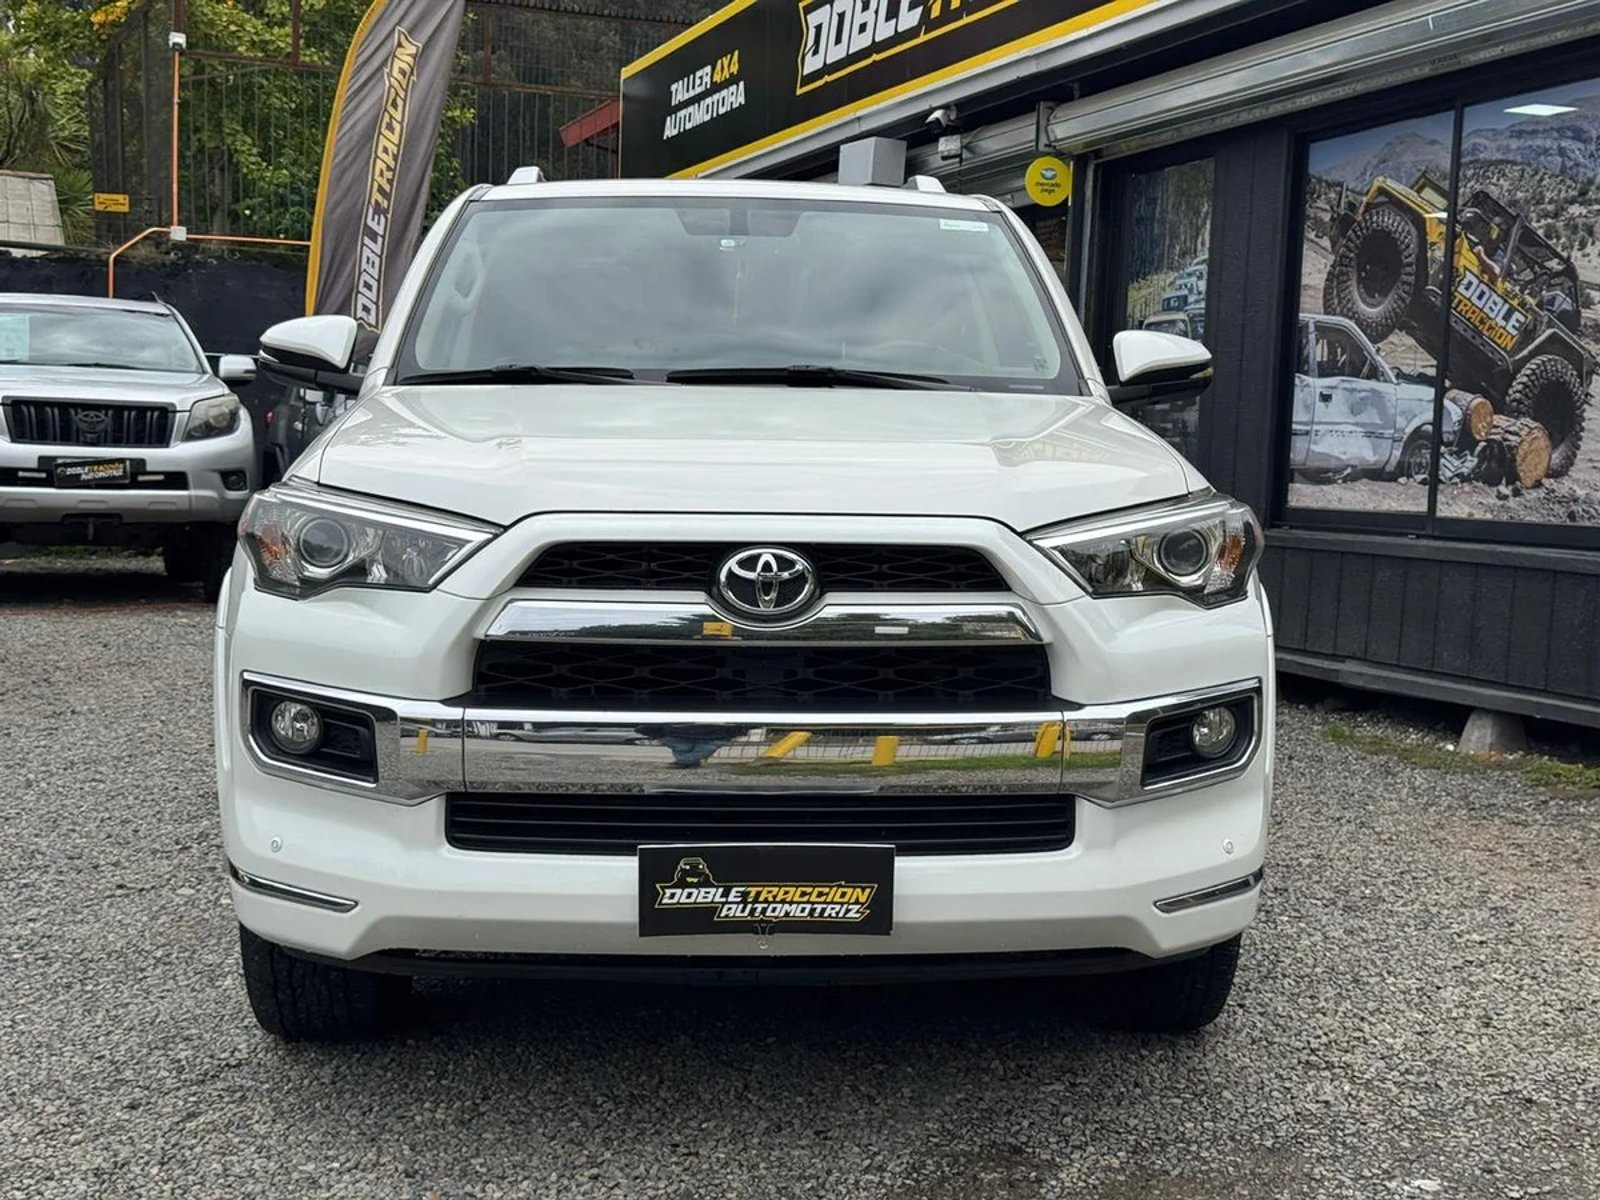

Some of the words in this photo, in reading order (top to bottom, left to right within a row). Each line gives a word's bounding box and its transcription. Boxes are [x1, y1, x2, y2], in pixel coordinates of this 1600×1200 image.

[670, 64, 712, 106] TALLER
[712, 49, 739, 84] 4X4
[663, 80, 745, 140] AUTOMOTORA
[1456, 270, 1526, 336] DOBLE
[720, 902, 864, 918] AUTOMOTRIZ
